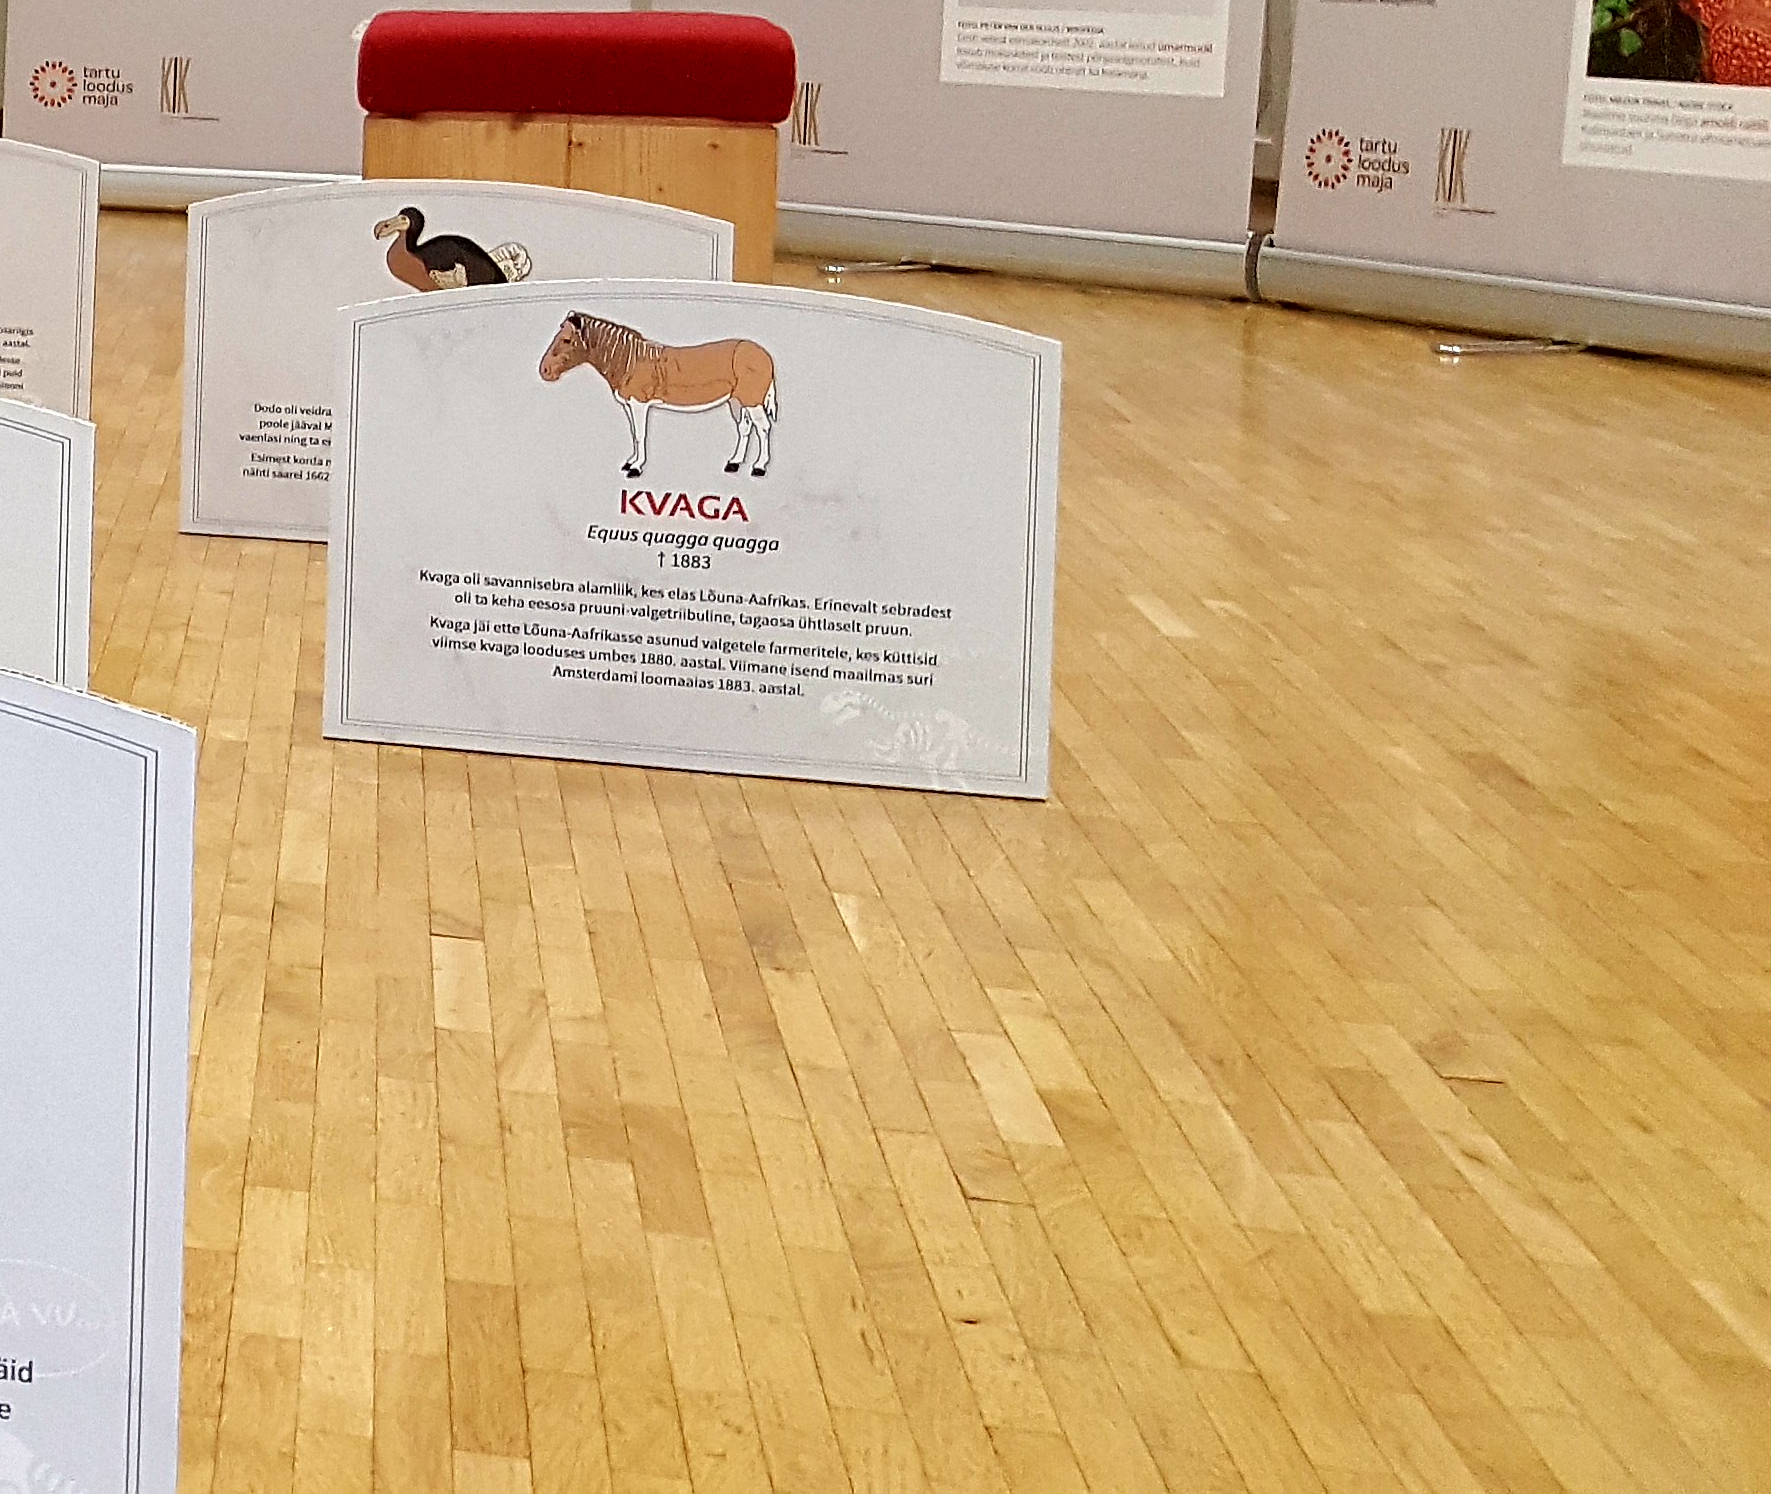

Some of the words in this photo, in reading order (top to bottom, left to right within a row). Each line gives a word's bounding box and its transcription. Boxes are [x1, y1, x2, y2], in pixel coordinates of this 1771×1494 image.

[83, 66, 121, 83] tartu
[82, 80, 134, 94] loodus
[82, 93, 119, 109] maja
[1359, 136, 1398, 156] tartu
[1357, 154, 1410, 174] loodus
[1356, 175, 1393, 193] maja
[620, 489, 749, 523] KVAGA
[587, 524, 640, 544] Equus
[642, 531, 709, 550] quagga
[712, 535, 780, 555] quagga
[671, 552, 711, 570] 1883
[419, 569, 460, 587] Kvaga
[463, 571, 481, 586] oli
[483, 576, 575, 593] savannisebra
[577, 580, 638, 600] alamliik,
[640, 584, 665, 599] kes
[667, 586, 697, 602] elas
[699, 588, 810, 610] Lõuna-Aafrikas.
[814, 597, 878, 615] Erinevalt
[881, 602, 952, 620] sebradest
